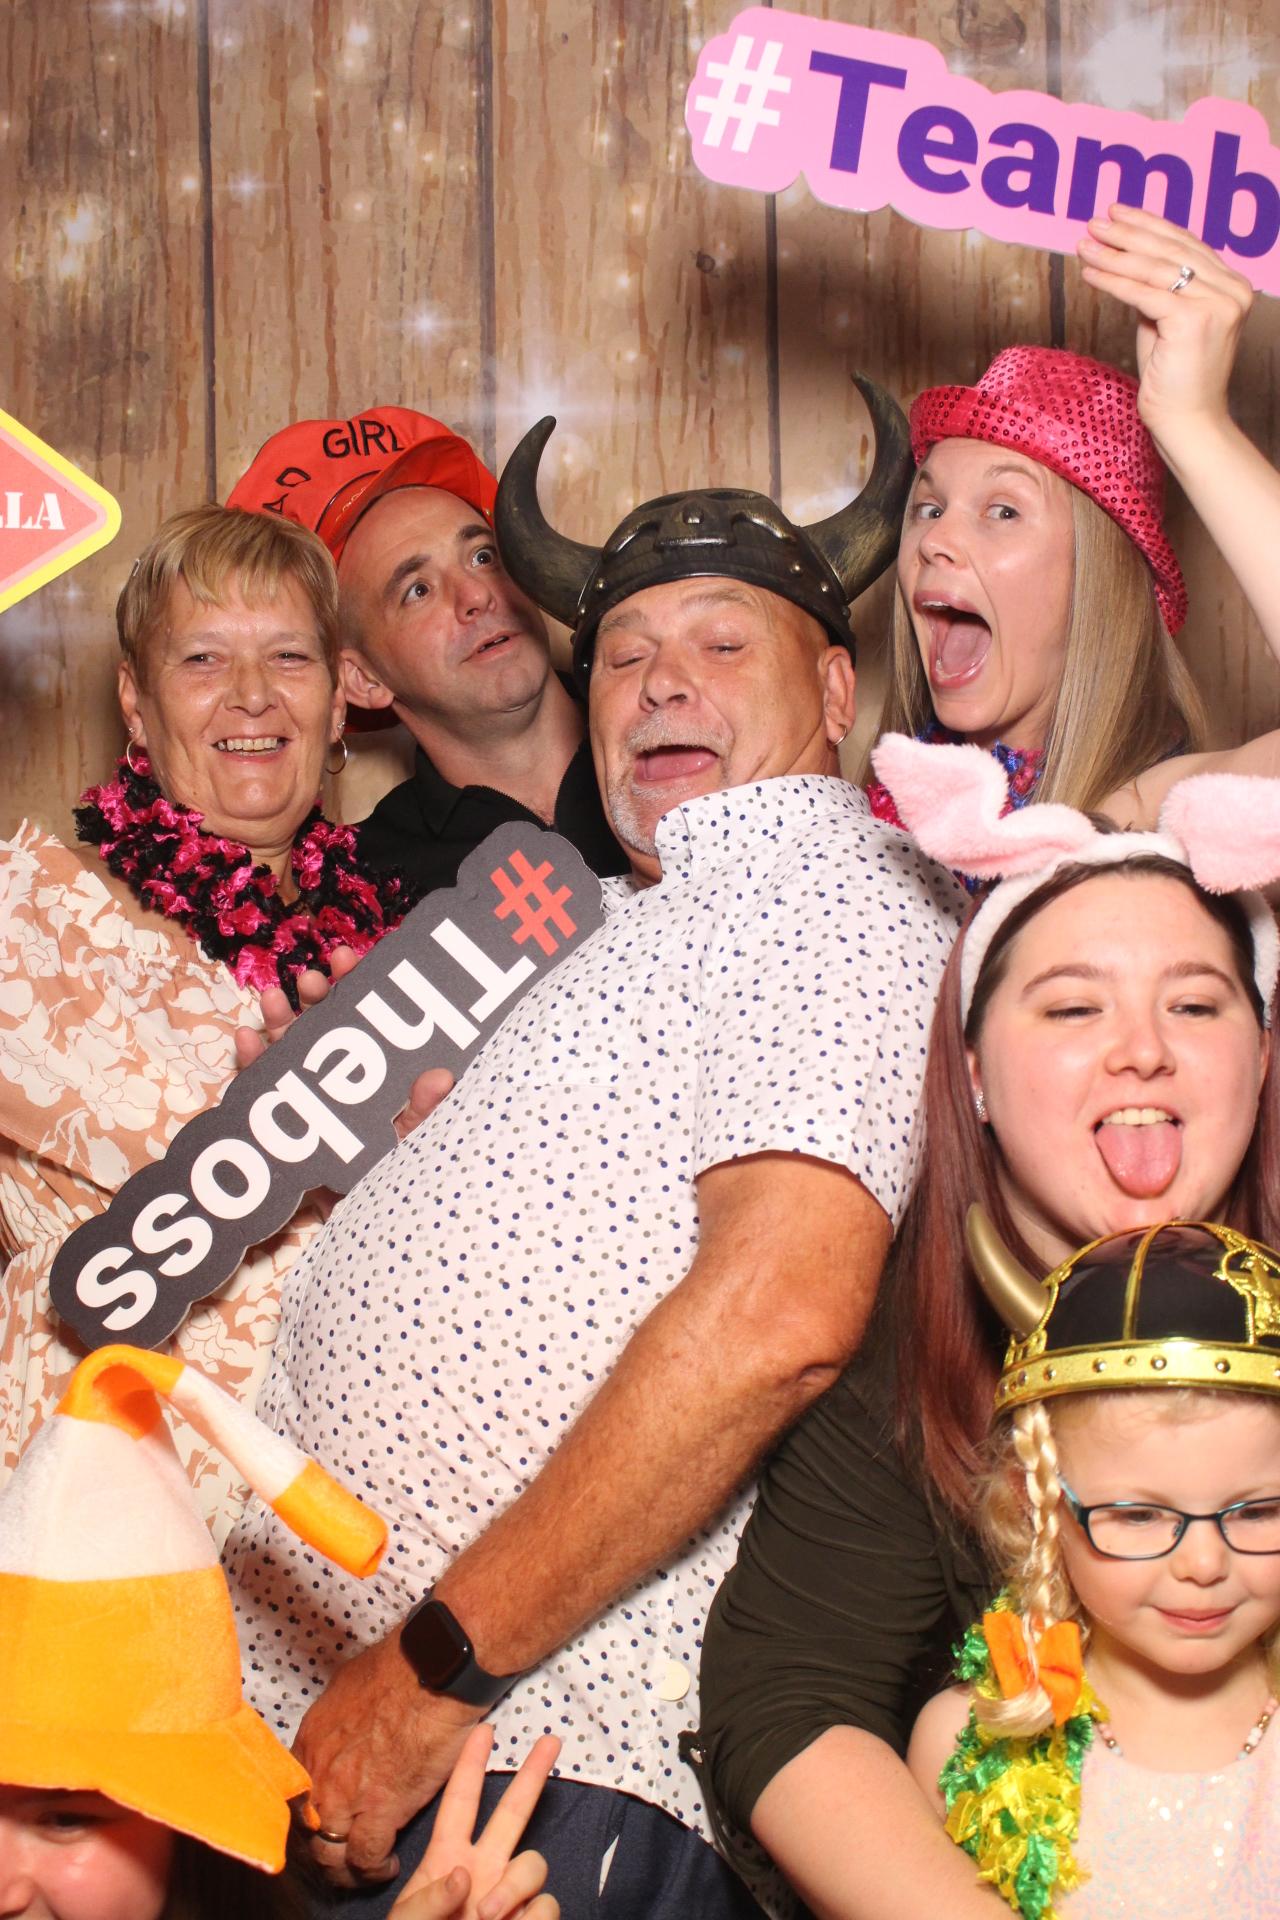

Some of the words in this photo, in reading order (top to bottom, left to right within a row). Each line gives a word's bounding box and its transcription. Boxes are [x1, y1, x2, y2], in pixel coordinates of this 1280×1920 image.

[322, 419, 406, 459] GIRL
[0, 491, 66, 531] LA
[75, 849, 578, 1332] #Theboss
